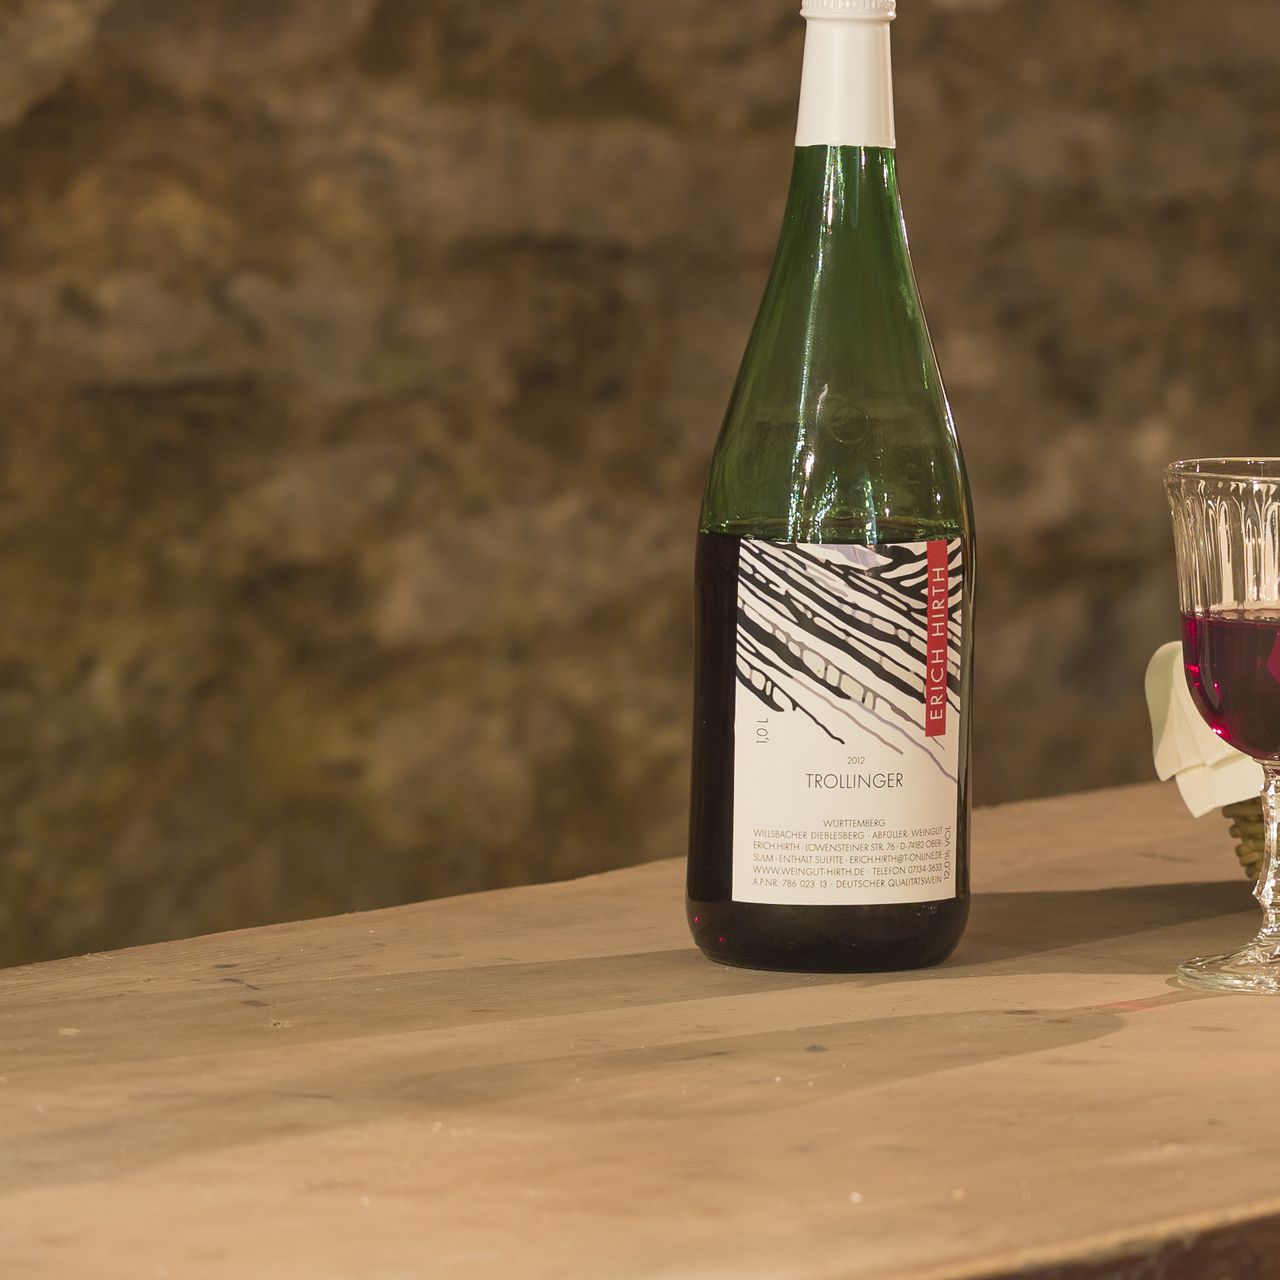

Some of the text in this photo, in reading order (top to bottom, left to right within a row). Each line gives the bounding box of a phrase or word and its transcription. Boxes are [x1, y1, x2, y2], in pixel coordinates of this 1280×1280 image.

[930, 567, 945, 720] ERICH HIRTH
[847, 756, 865, 765] 2012
[806, 773, 903, 788] TROLLINGER
[823, 819, 885, 827] WÜRTTEMBERG
[754, 829, 807, 839] WILLSBACHER
[911, 826, 943, 837] WEINGUT
[754, 841, 775, 850] ERICH
[753, 853, 773, 862] SULM
[815, 855, 844, 864] SULFITE
[753, 866, 864, 876] WWW.WEINGUT-HIRTH.DE
[873, 867, 905, 875] TELEFON
[783, 879, 796, 888] 786
[800, 880, 815, 888] 023
[820, 880, 827, 888] 13
[836, 880, 885, 888] DEUTSCHER
